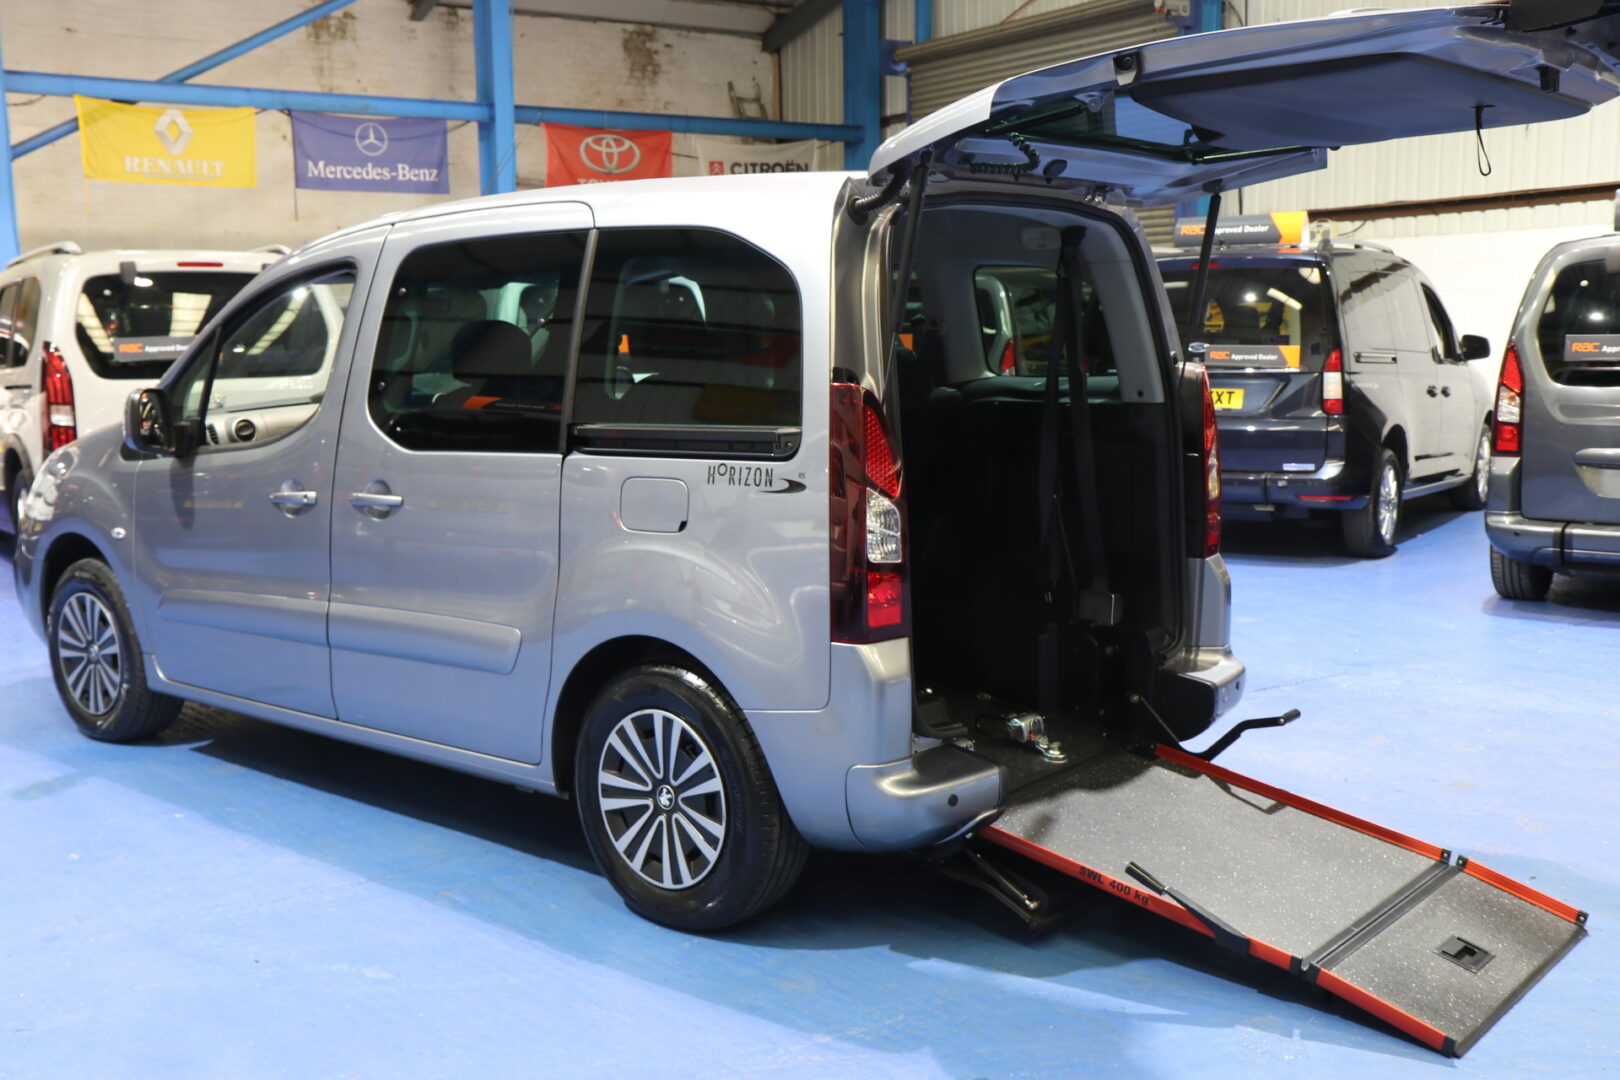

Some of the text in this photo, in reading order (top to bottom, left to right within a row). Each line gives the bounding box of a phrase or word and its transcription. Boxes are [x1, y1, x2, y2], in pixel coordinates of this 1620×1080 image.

[124, 155, 225, 178] RENAULT
[306, 160, 440, 183] Mercedes-Benz
[1243, 224, 1270, 233] Dealer
[145, 344, 175, 353] Approved
[1231, 352, 1257, 361] Approved
[1258, 352, 1278, 360] Dealer
[1210, 391, 1235, 405] XT
[707, 462, 774, 487] HORIZON
[1079, 865, 1150, 906] SWL 400 kg
